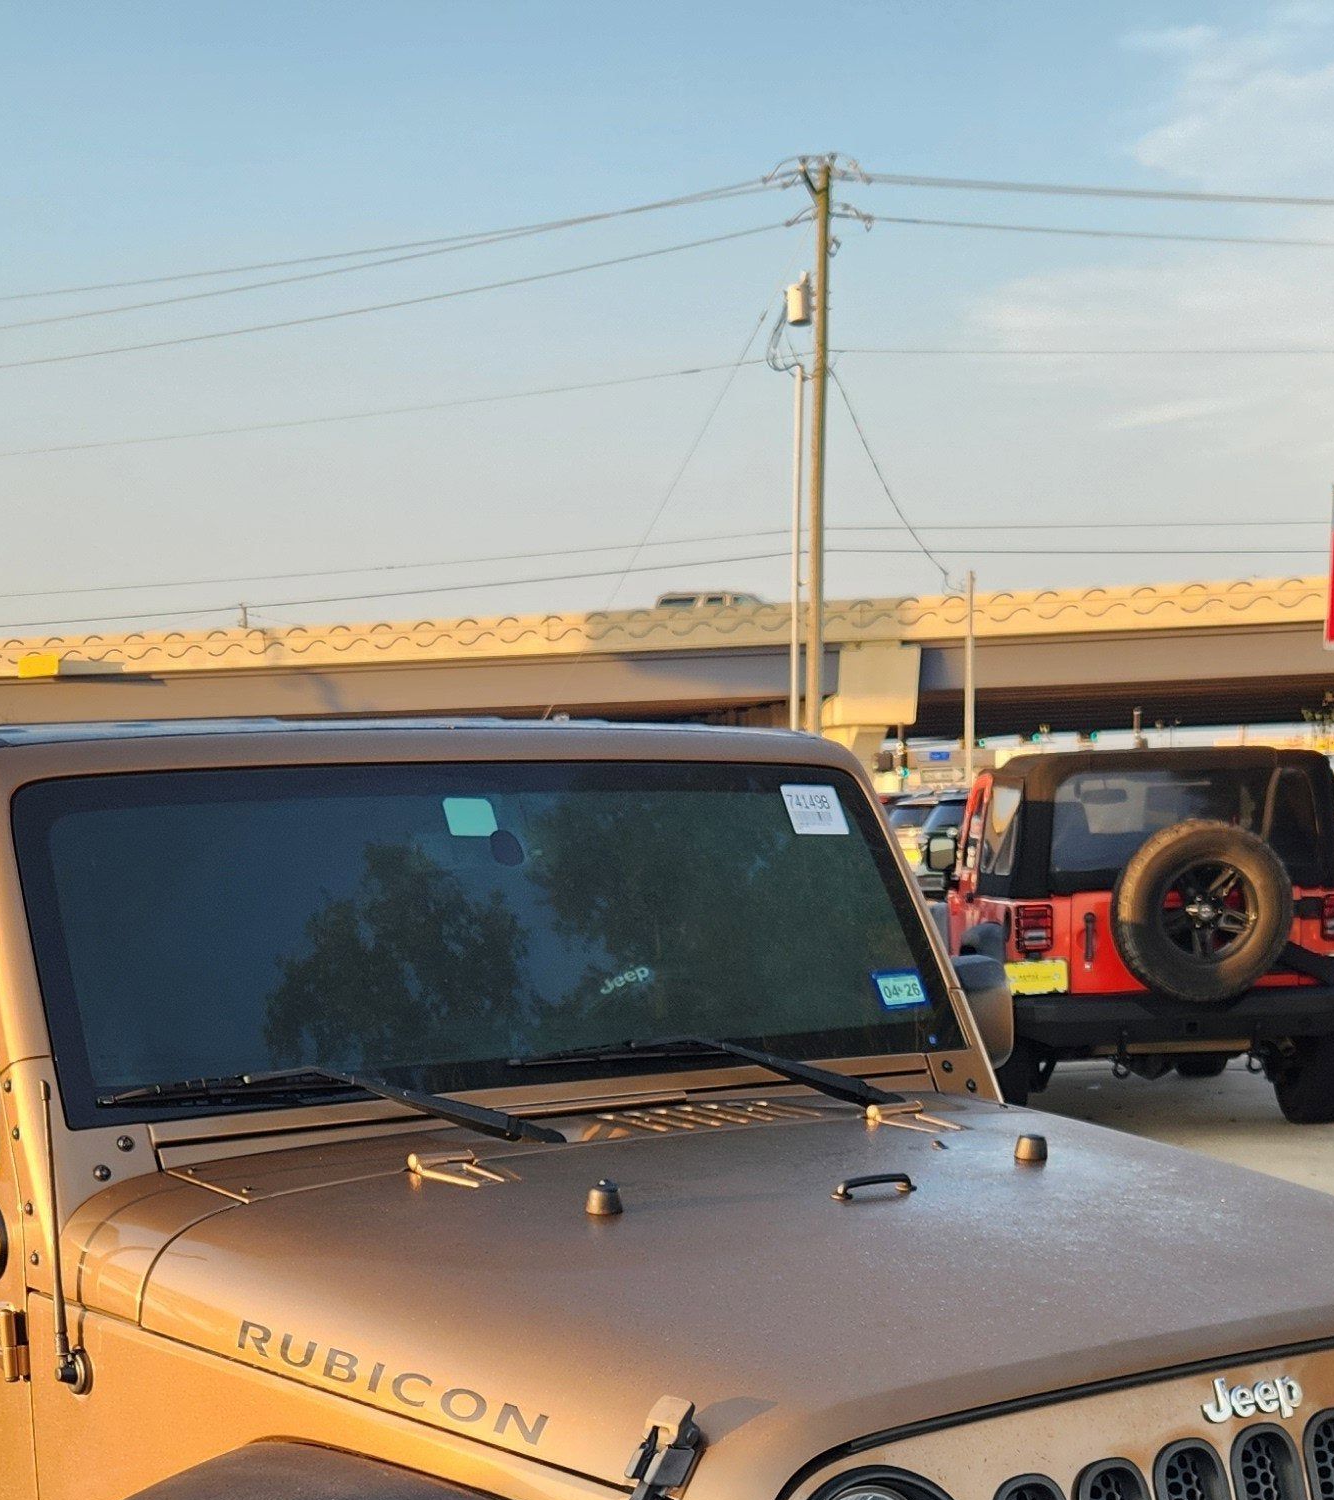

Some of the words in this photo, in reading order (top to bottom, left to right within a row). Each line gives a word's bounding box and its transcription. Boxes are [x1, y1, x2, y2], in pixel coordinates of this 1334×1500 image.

[785, 793, 831, 810] 741498
[599, 966, 650, 995] Jeep
[903, 983, 921, 997] 26
[236, 1319, 550, 1446] RUBICON
[1201, 1375, 1304, 1423] Jeep
